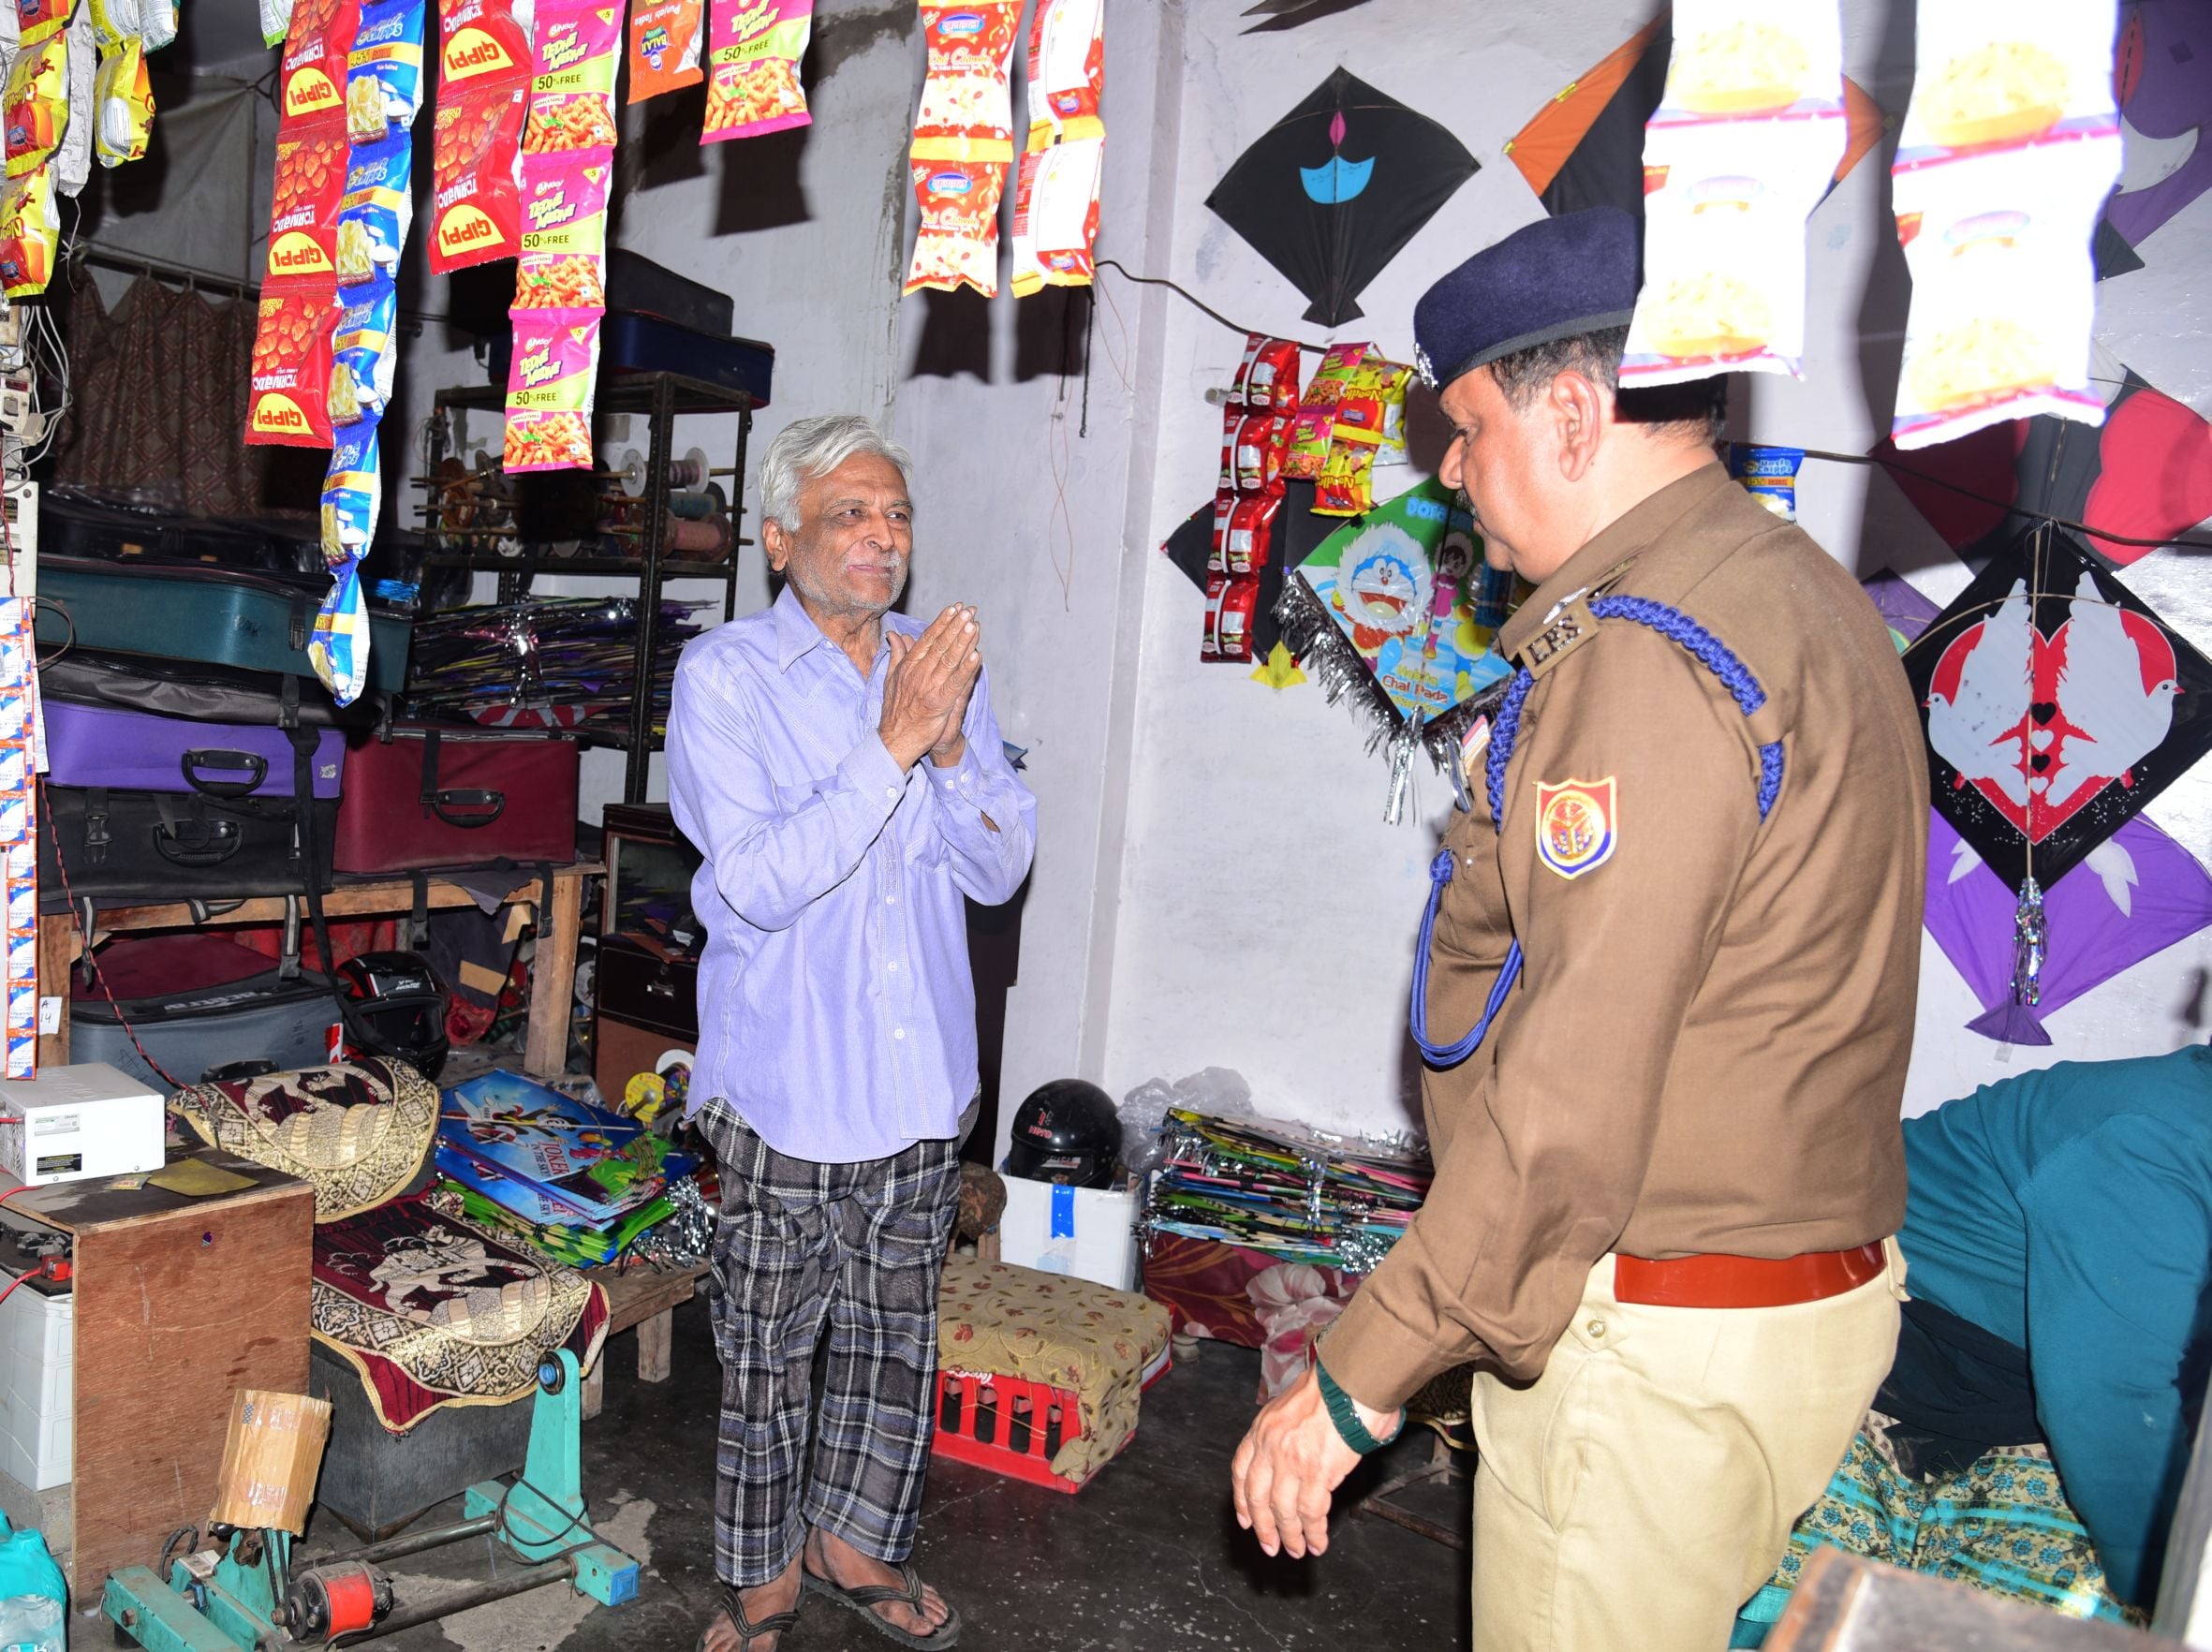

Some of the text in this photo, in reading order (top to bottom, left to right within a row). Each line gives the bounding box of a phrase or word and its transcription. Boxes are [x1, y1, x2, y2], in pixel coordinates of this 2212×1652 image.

[641, 35, 668, 53] BALAJI
[748, 39, 769, 54] FREE
[448, 40, 499, 70] GIPPI
[560, 74, 582, 85] FREE
[289, 80, 332, 106] GIPPI
[442, 217, 493, 246] GIPPI
[547, 234, 569, 243] FREE
[273, 245, 321, 267] GIPPI
[536, 392, 557, 403] FREE
[258, 406, 302, 427] GIPPI
[1382, 674, 1411, 692] Chal
